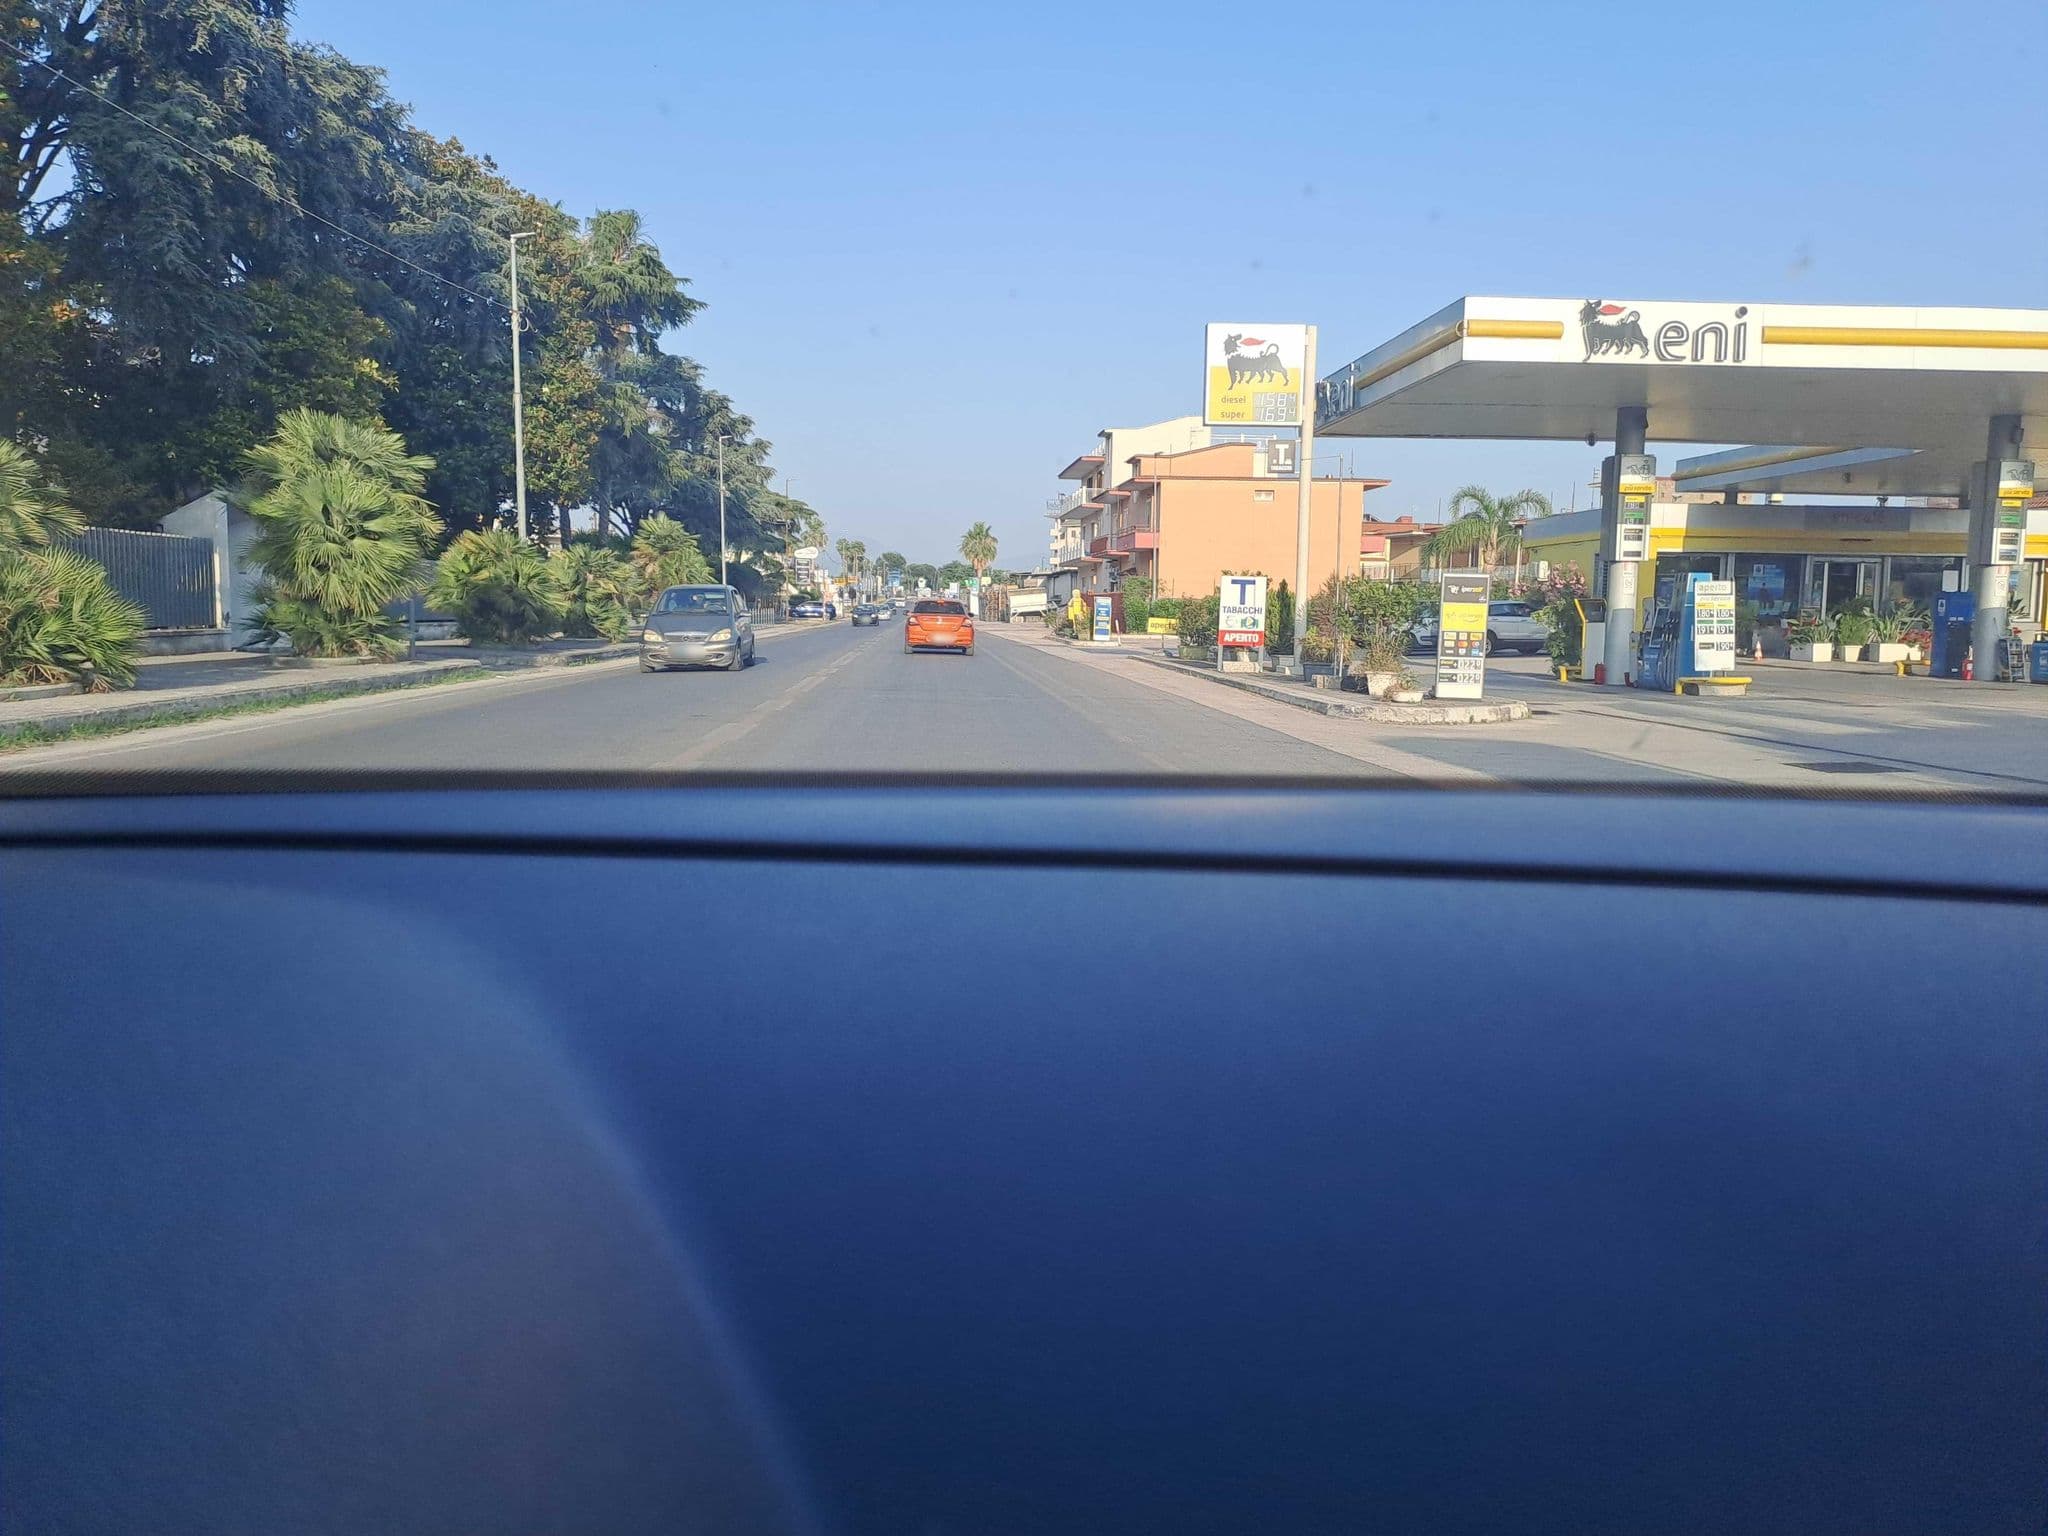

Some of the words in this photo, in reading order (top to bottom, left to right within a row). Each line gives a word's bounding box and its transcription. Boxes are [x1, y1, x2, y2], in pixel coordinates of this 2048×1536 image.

[1654, 306, 1748, 363] eni
[1220, 395, 1247, 404] diesel
[1220, 411, 1245, 420] super
[1231, 579, 1256, 605] T
[1223, 606, 1263, 615] TABACCHI
[1223, 632, 1260, 643] APERTO
